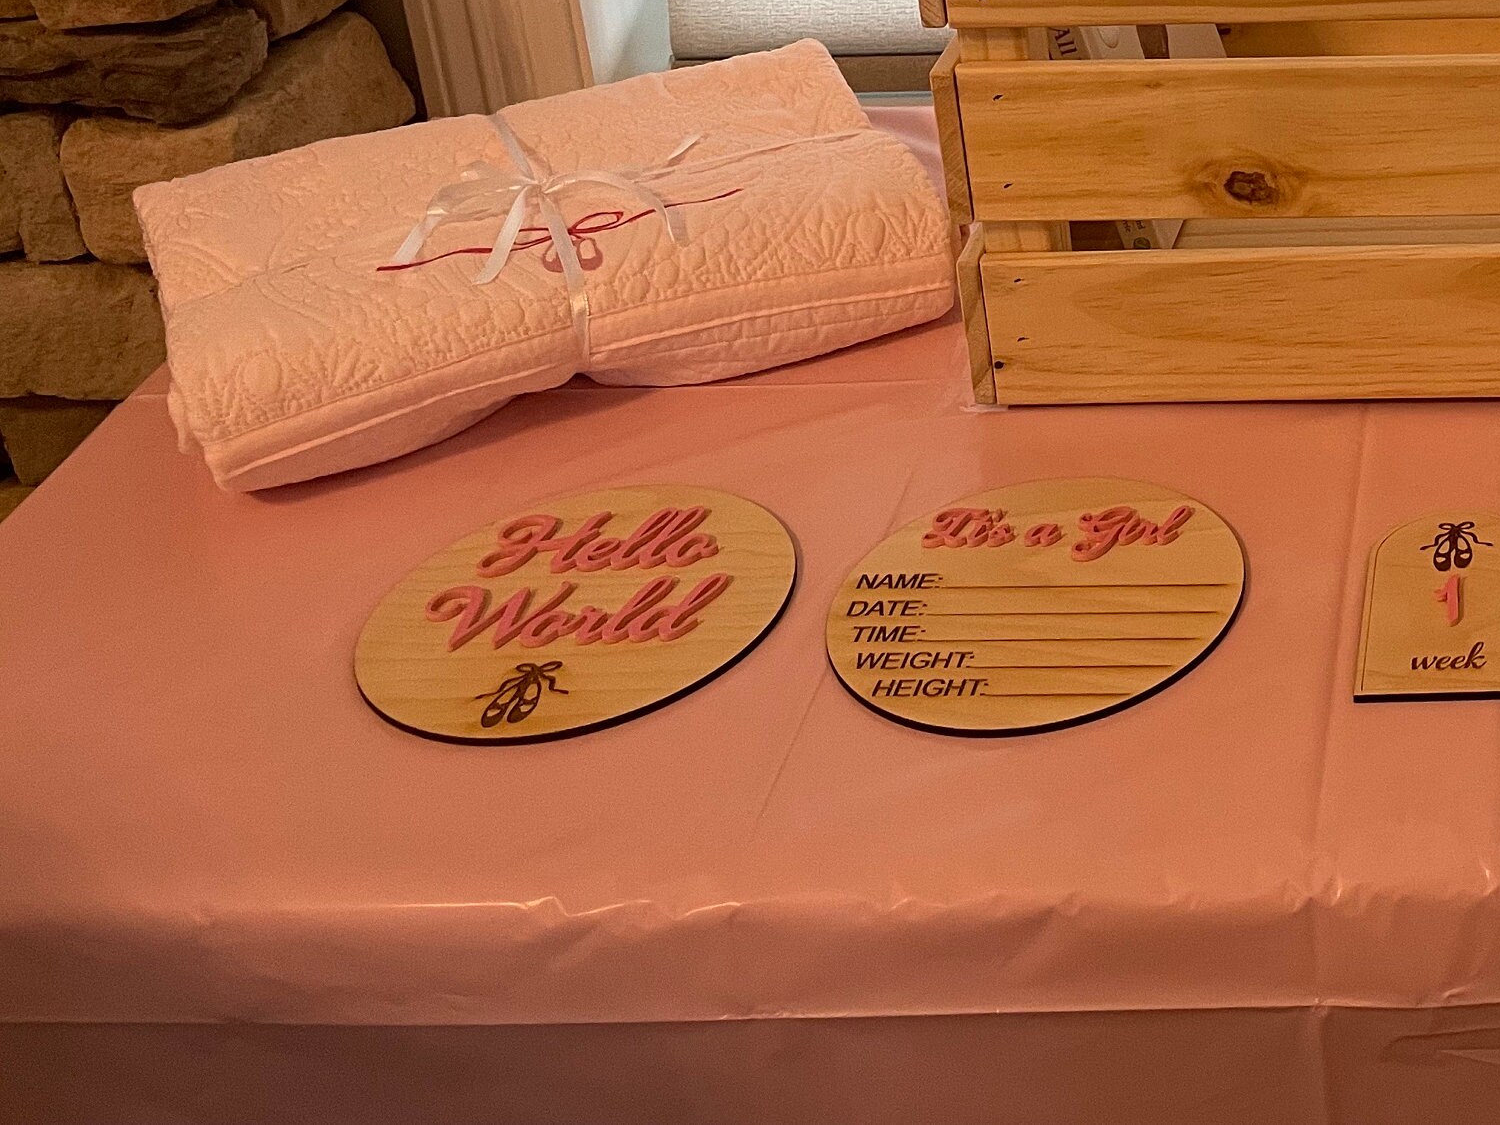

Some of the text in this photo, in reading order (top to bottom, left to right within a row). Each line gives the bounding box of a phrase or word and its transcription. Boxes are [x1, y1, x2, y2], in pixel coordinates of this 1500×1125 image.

[475, 505, 722, 578] Hello
[1025, 520, 1063, 547] a
[1071, 505, 1195, 563] Girl
[855, 573, 944, 590] NAME:
[424, 572, 733, 652] World
[846, 600, 929, 618] DATE:
[852, 626, 926, 643] TIME:
[855, 652, 974, 670] WEIGHT:
[1410, 642, 1486, 671] week
[871, 679, 988, 697] HEIGHT:
